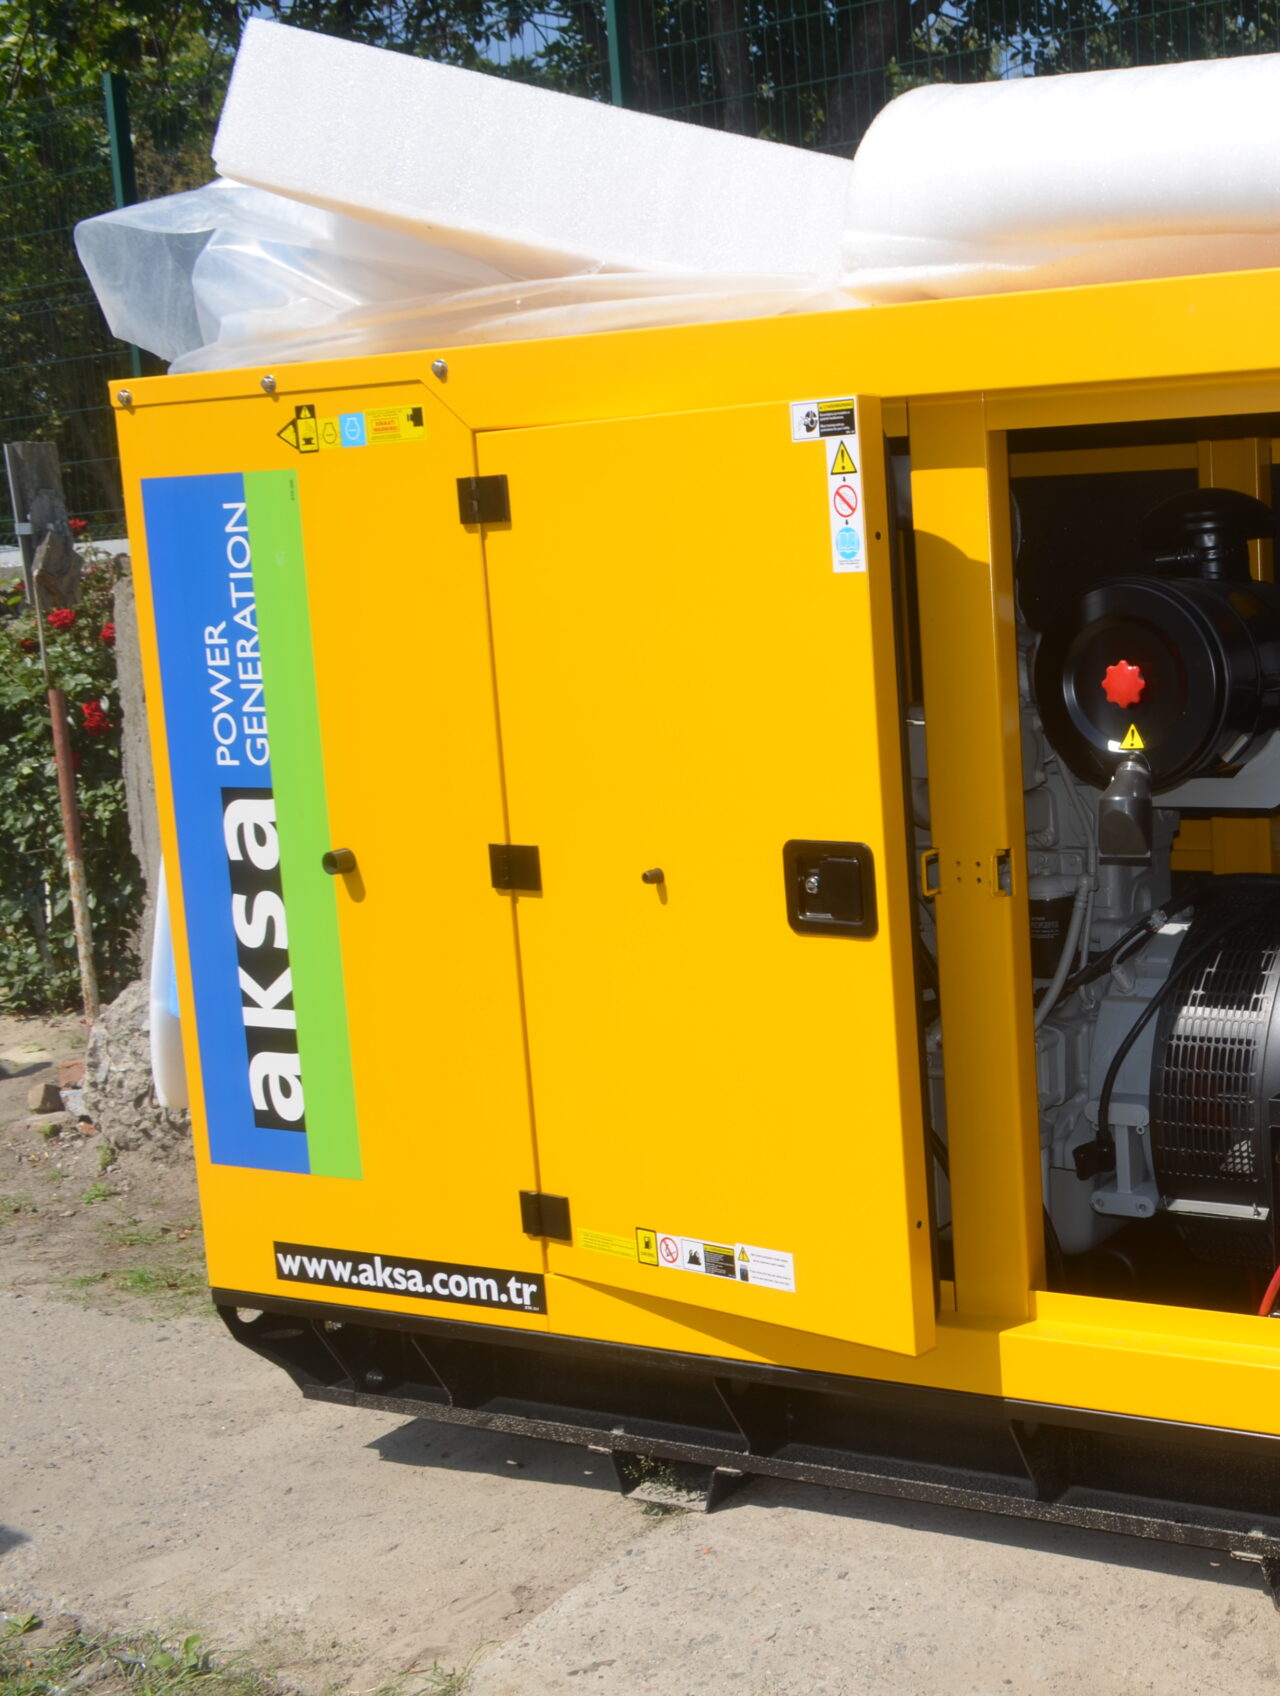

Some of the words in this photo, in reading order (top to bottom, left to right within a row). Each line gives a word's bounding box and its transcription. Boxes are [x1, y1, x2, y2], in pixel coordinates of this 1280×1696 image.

[204, 620, 240, 766] POWER
[222, 501, 271, 767] GENERATION
[223, 798, 306, 1122] aksa
[276, 1253, 537, 1306] www.aksa.com.tr
